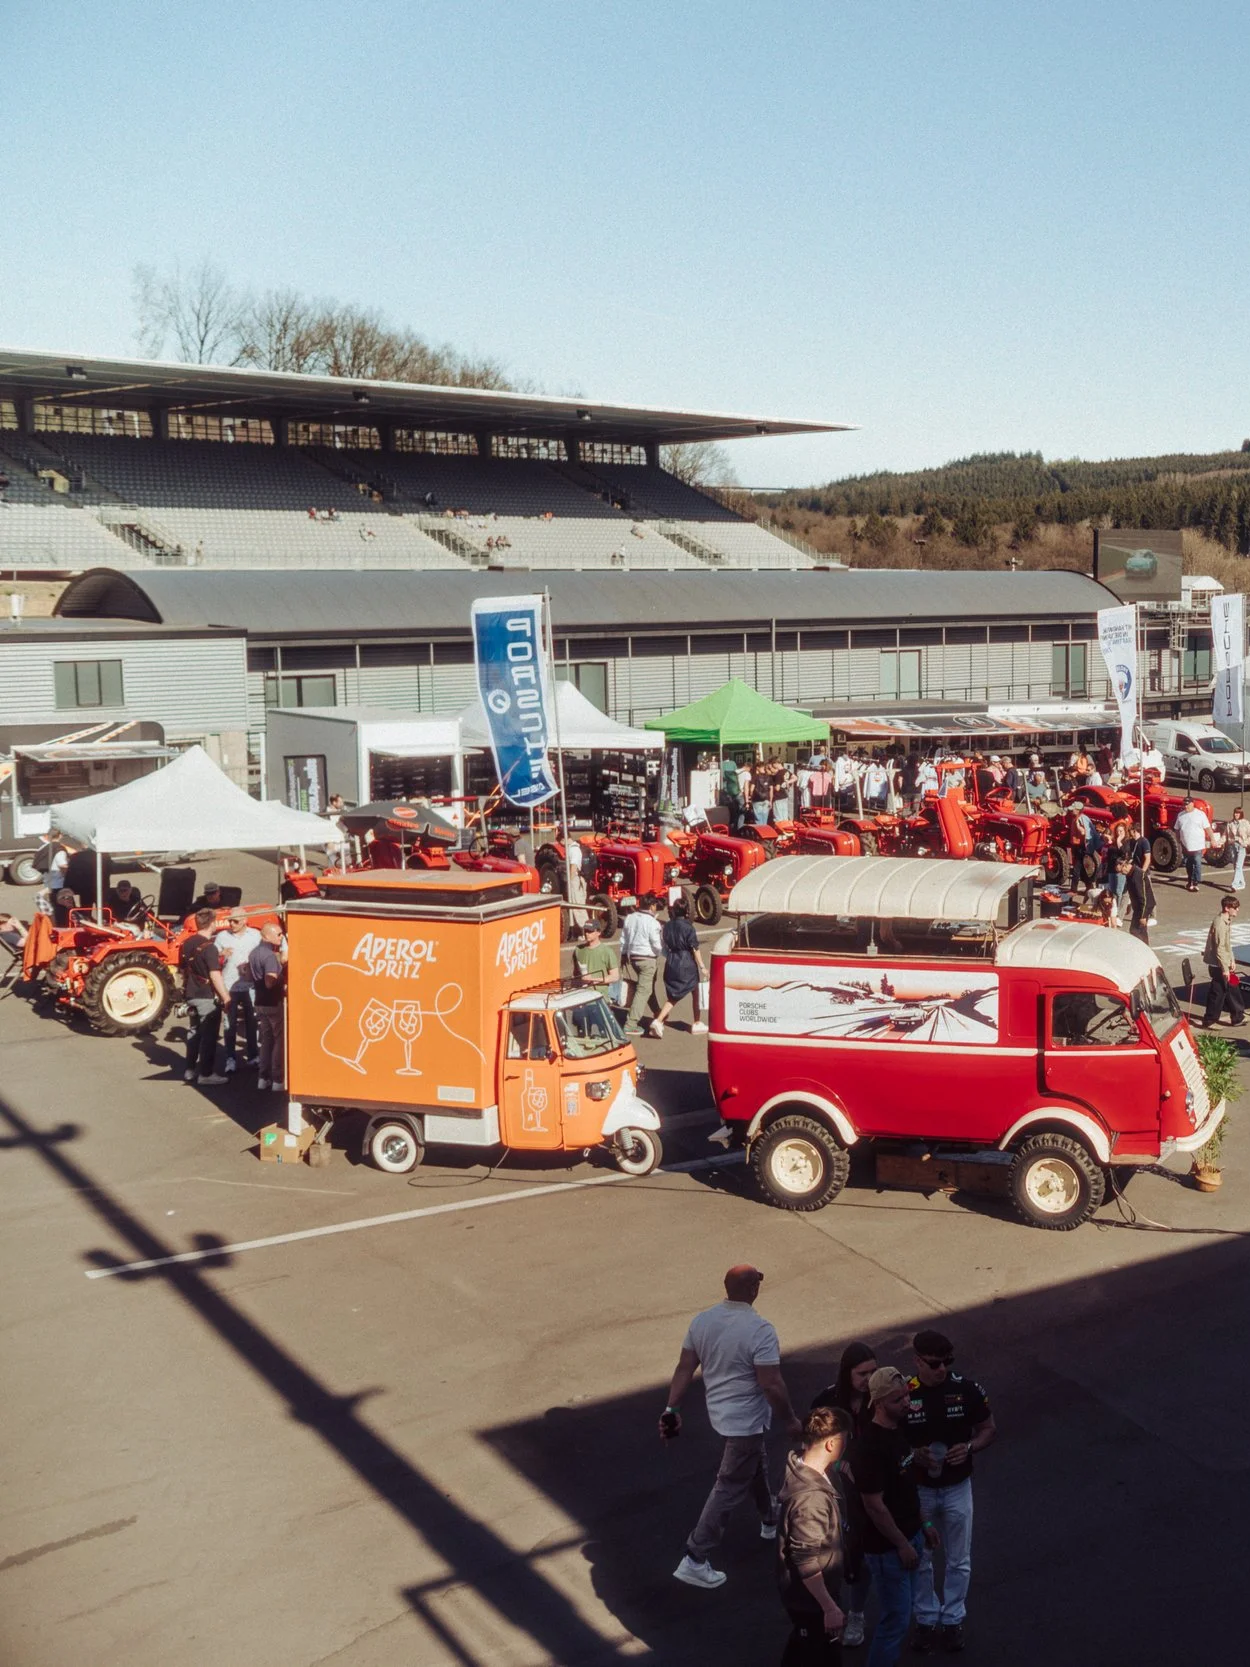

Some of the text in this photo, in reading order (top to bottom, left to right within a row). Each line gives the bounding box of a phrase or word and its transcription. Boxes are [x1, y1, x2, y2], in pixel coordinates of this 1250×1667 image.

[352, 932, 437, 964] APEROL
[495, 918, 546, 967] APEROL
[739, 1002, 767, 1010] PORSCHE
[739, 1015, 777, 1023] WORLDWIDE
